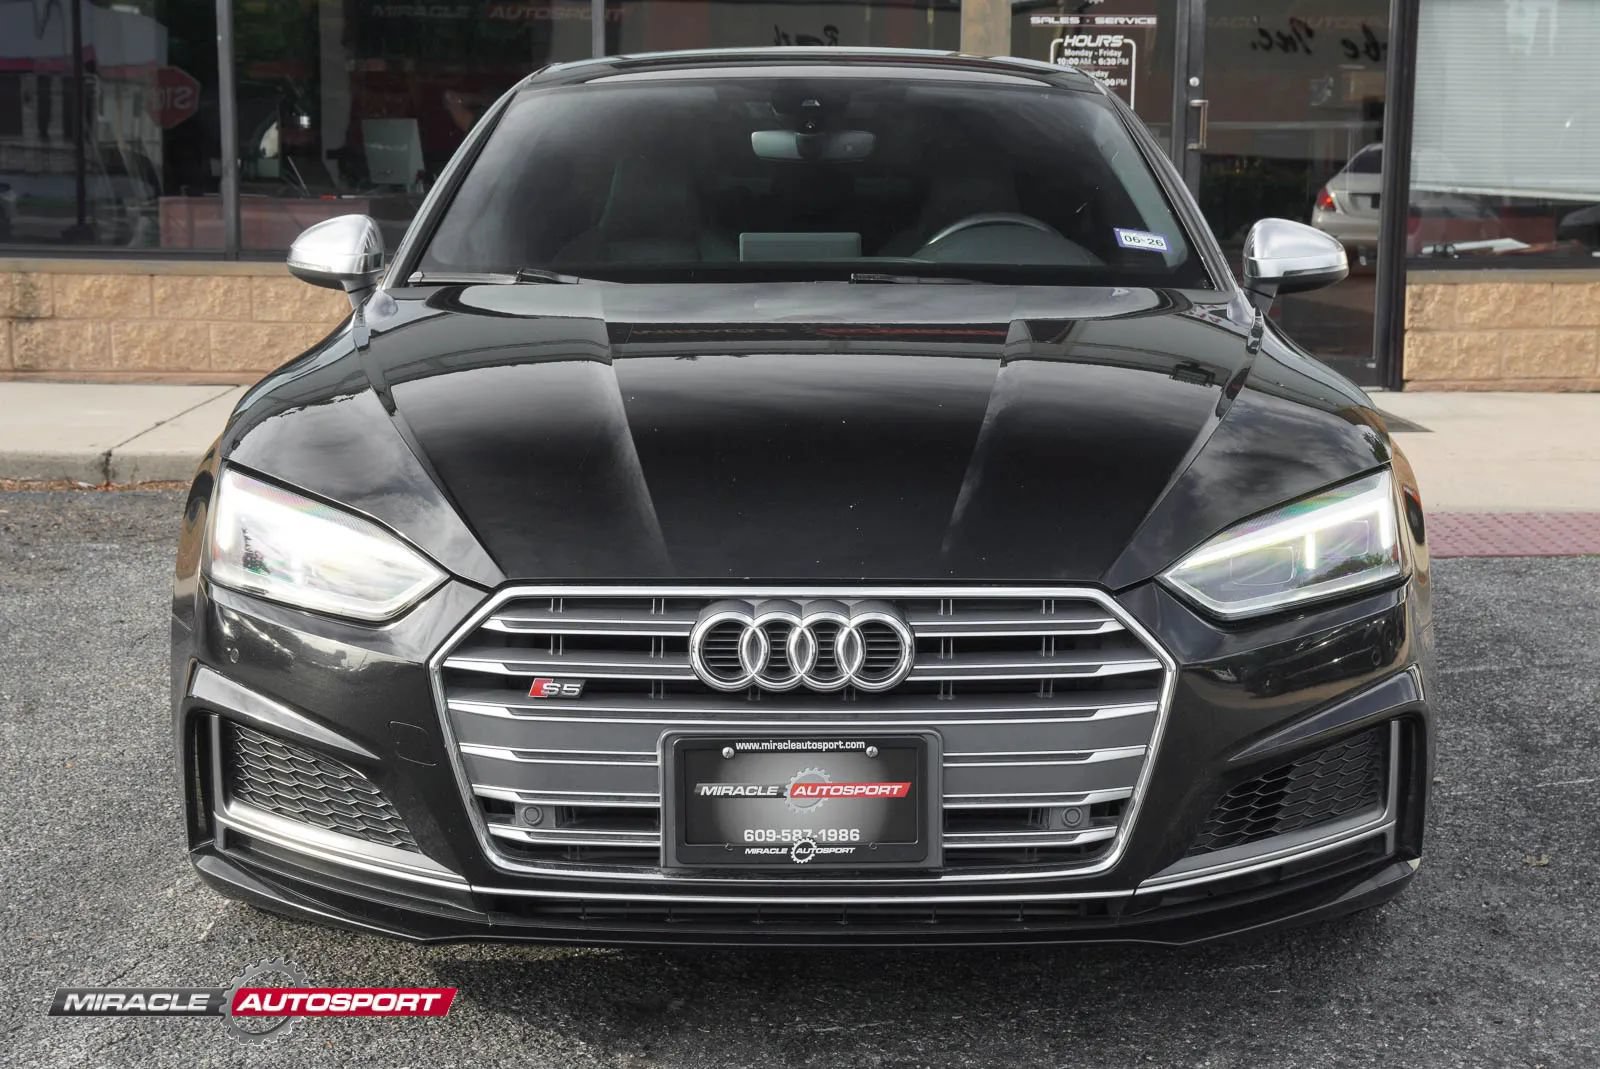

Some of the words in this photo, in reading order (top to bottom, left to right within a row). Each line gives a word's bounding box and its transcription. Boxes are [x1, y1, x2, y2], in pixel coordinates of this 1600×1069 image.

[1030, 17, 1080, 25] SALES
[1095, 17, 1157, 25] SERVICE
[1063, 35, 1124, 47] HOURS
[1064, 48, 1093, 57] Monday
[1099, 48, 1122, 57] Friday
[1057, 58, 1079, 66] 10:00
[542, 682, 582, 696] S5
[735, 740, 866, 751] www.miracleautosport.com
[700, 785, 779, 796] MIRACLE
[793, 785, 903, 796] AUTOSPORT
[743, 829, 860, 842] 609-587-1986
[744, 847, 788, 855] MIRACLE
[796, 847, 855, 855] AUTOSPORT
